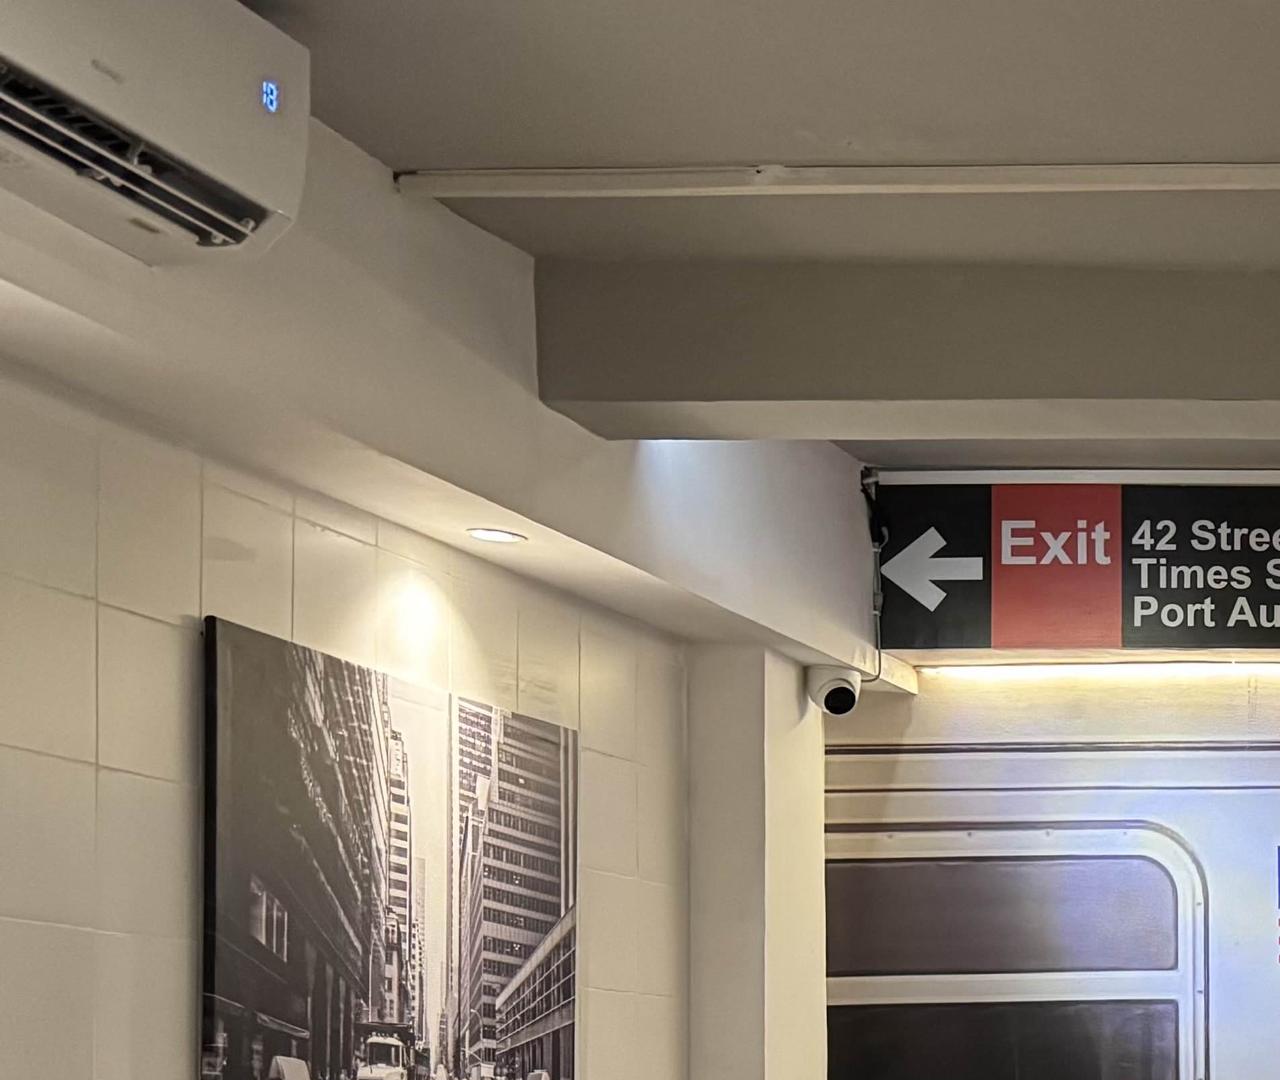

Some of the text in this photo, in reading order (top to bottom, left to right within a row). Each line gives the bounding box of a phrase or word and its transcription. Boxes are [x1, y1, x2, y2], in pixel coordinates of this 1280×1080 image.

[1001, 519, 1112, 566] Exit
[1131, 519, 1177, 551] 42
[1131, 557, 1252, 590] Times
[1133, 595, 1216, 628] Port
